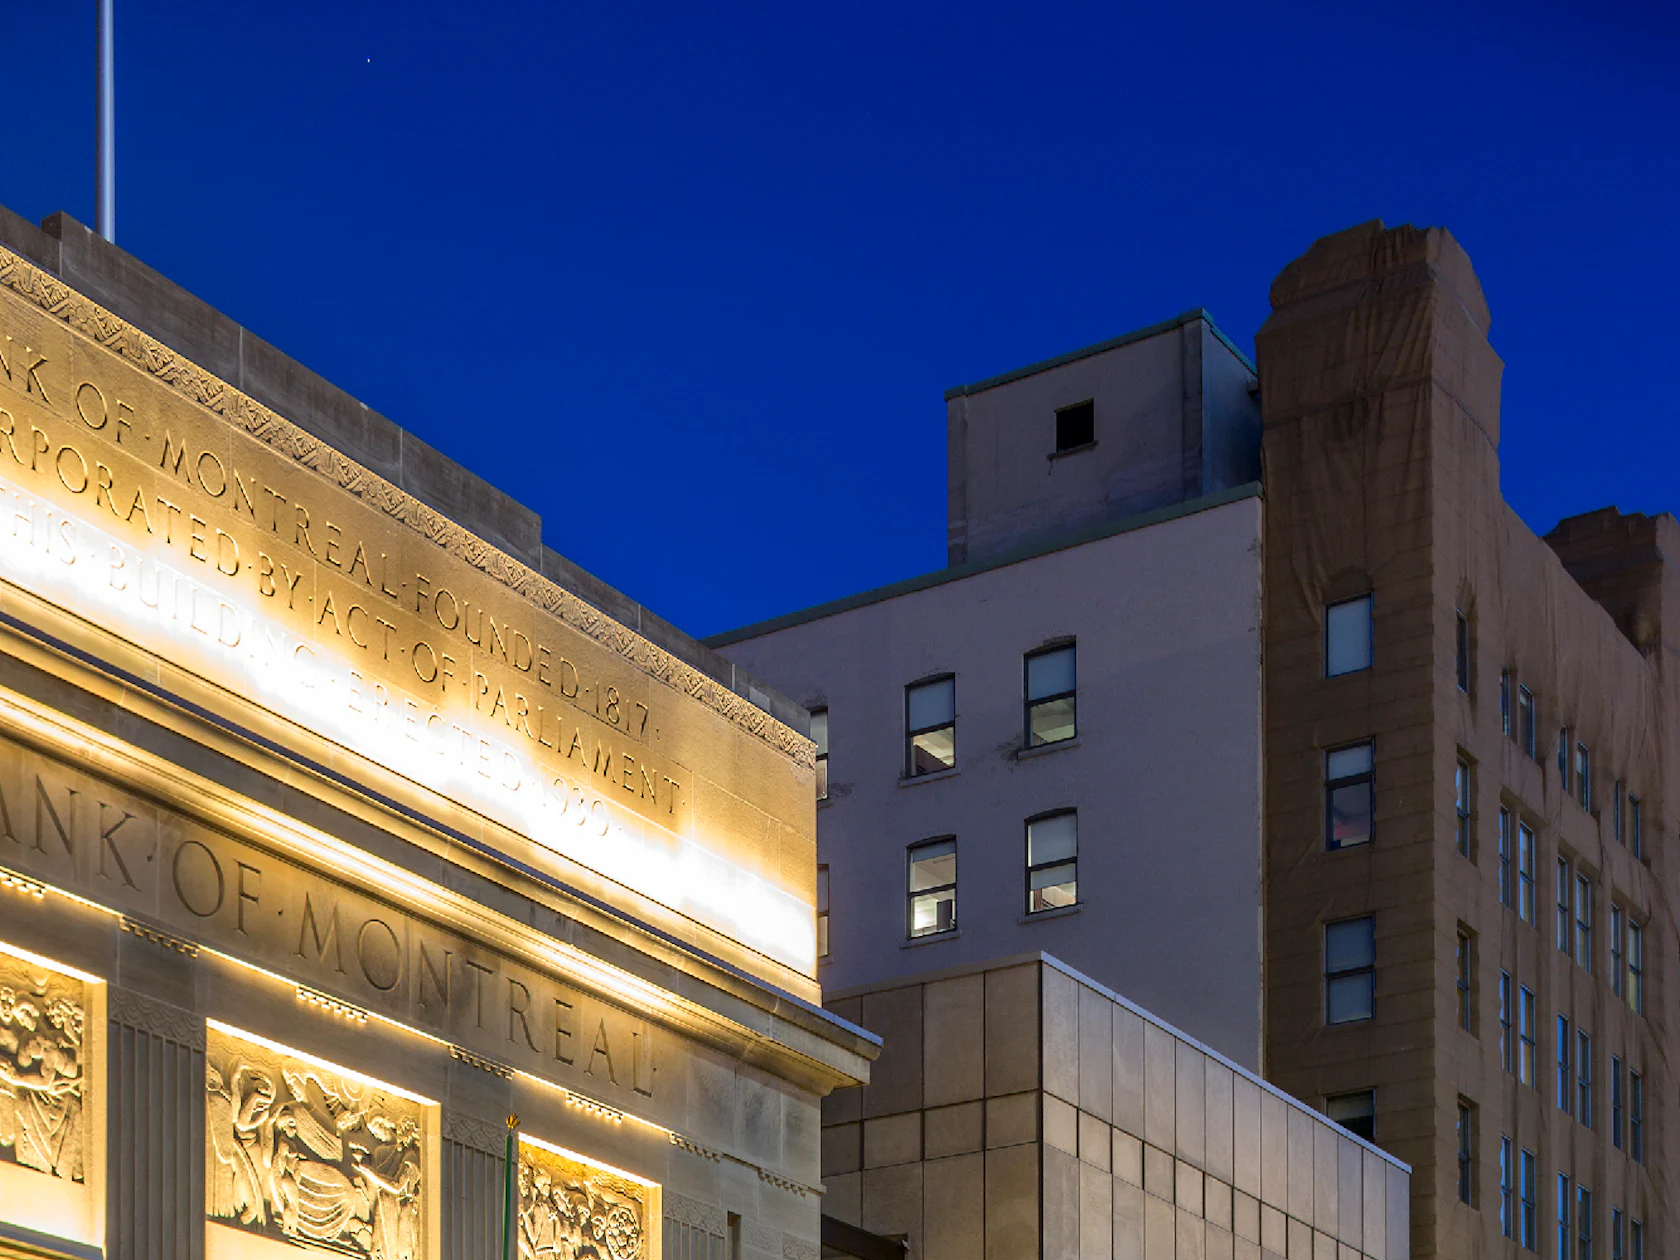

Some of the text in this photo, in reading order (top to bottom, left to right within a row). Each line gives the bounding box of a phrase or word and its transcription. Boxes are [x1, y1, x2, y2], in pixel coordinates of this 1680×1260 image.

[0, 483, 76, 565] HIS
[108, 541, 315, 689] BUILDING
[348, 669, 522, 791] ERECTED
[76, 380, 134, 443] OF
[160, 429, 398, 600] MONTREAL
[415, 573, 579, 698] FOUNDED
[594, 680, 649, 738] 1817
[258, 551, 303, 609] BY
[316, 590, 398, 662] ACT
[411, 641, 456, 692] OF
[474, 671, 681, 814] PARLIAMENT
[172, 840, 262, 936] OF
[294, 892, 654, 1099] MONTREAL
